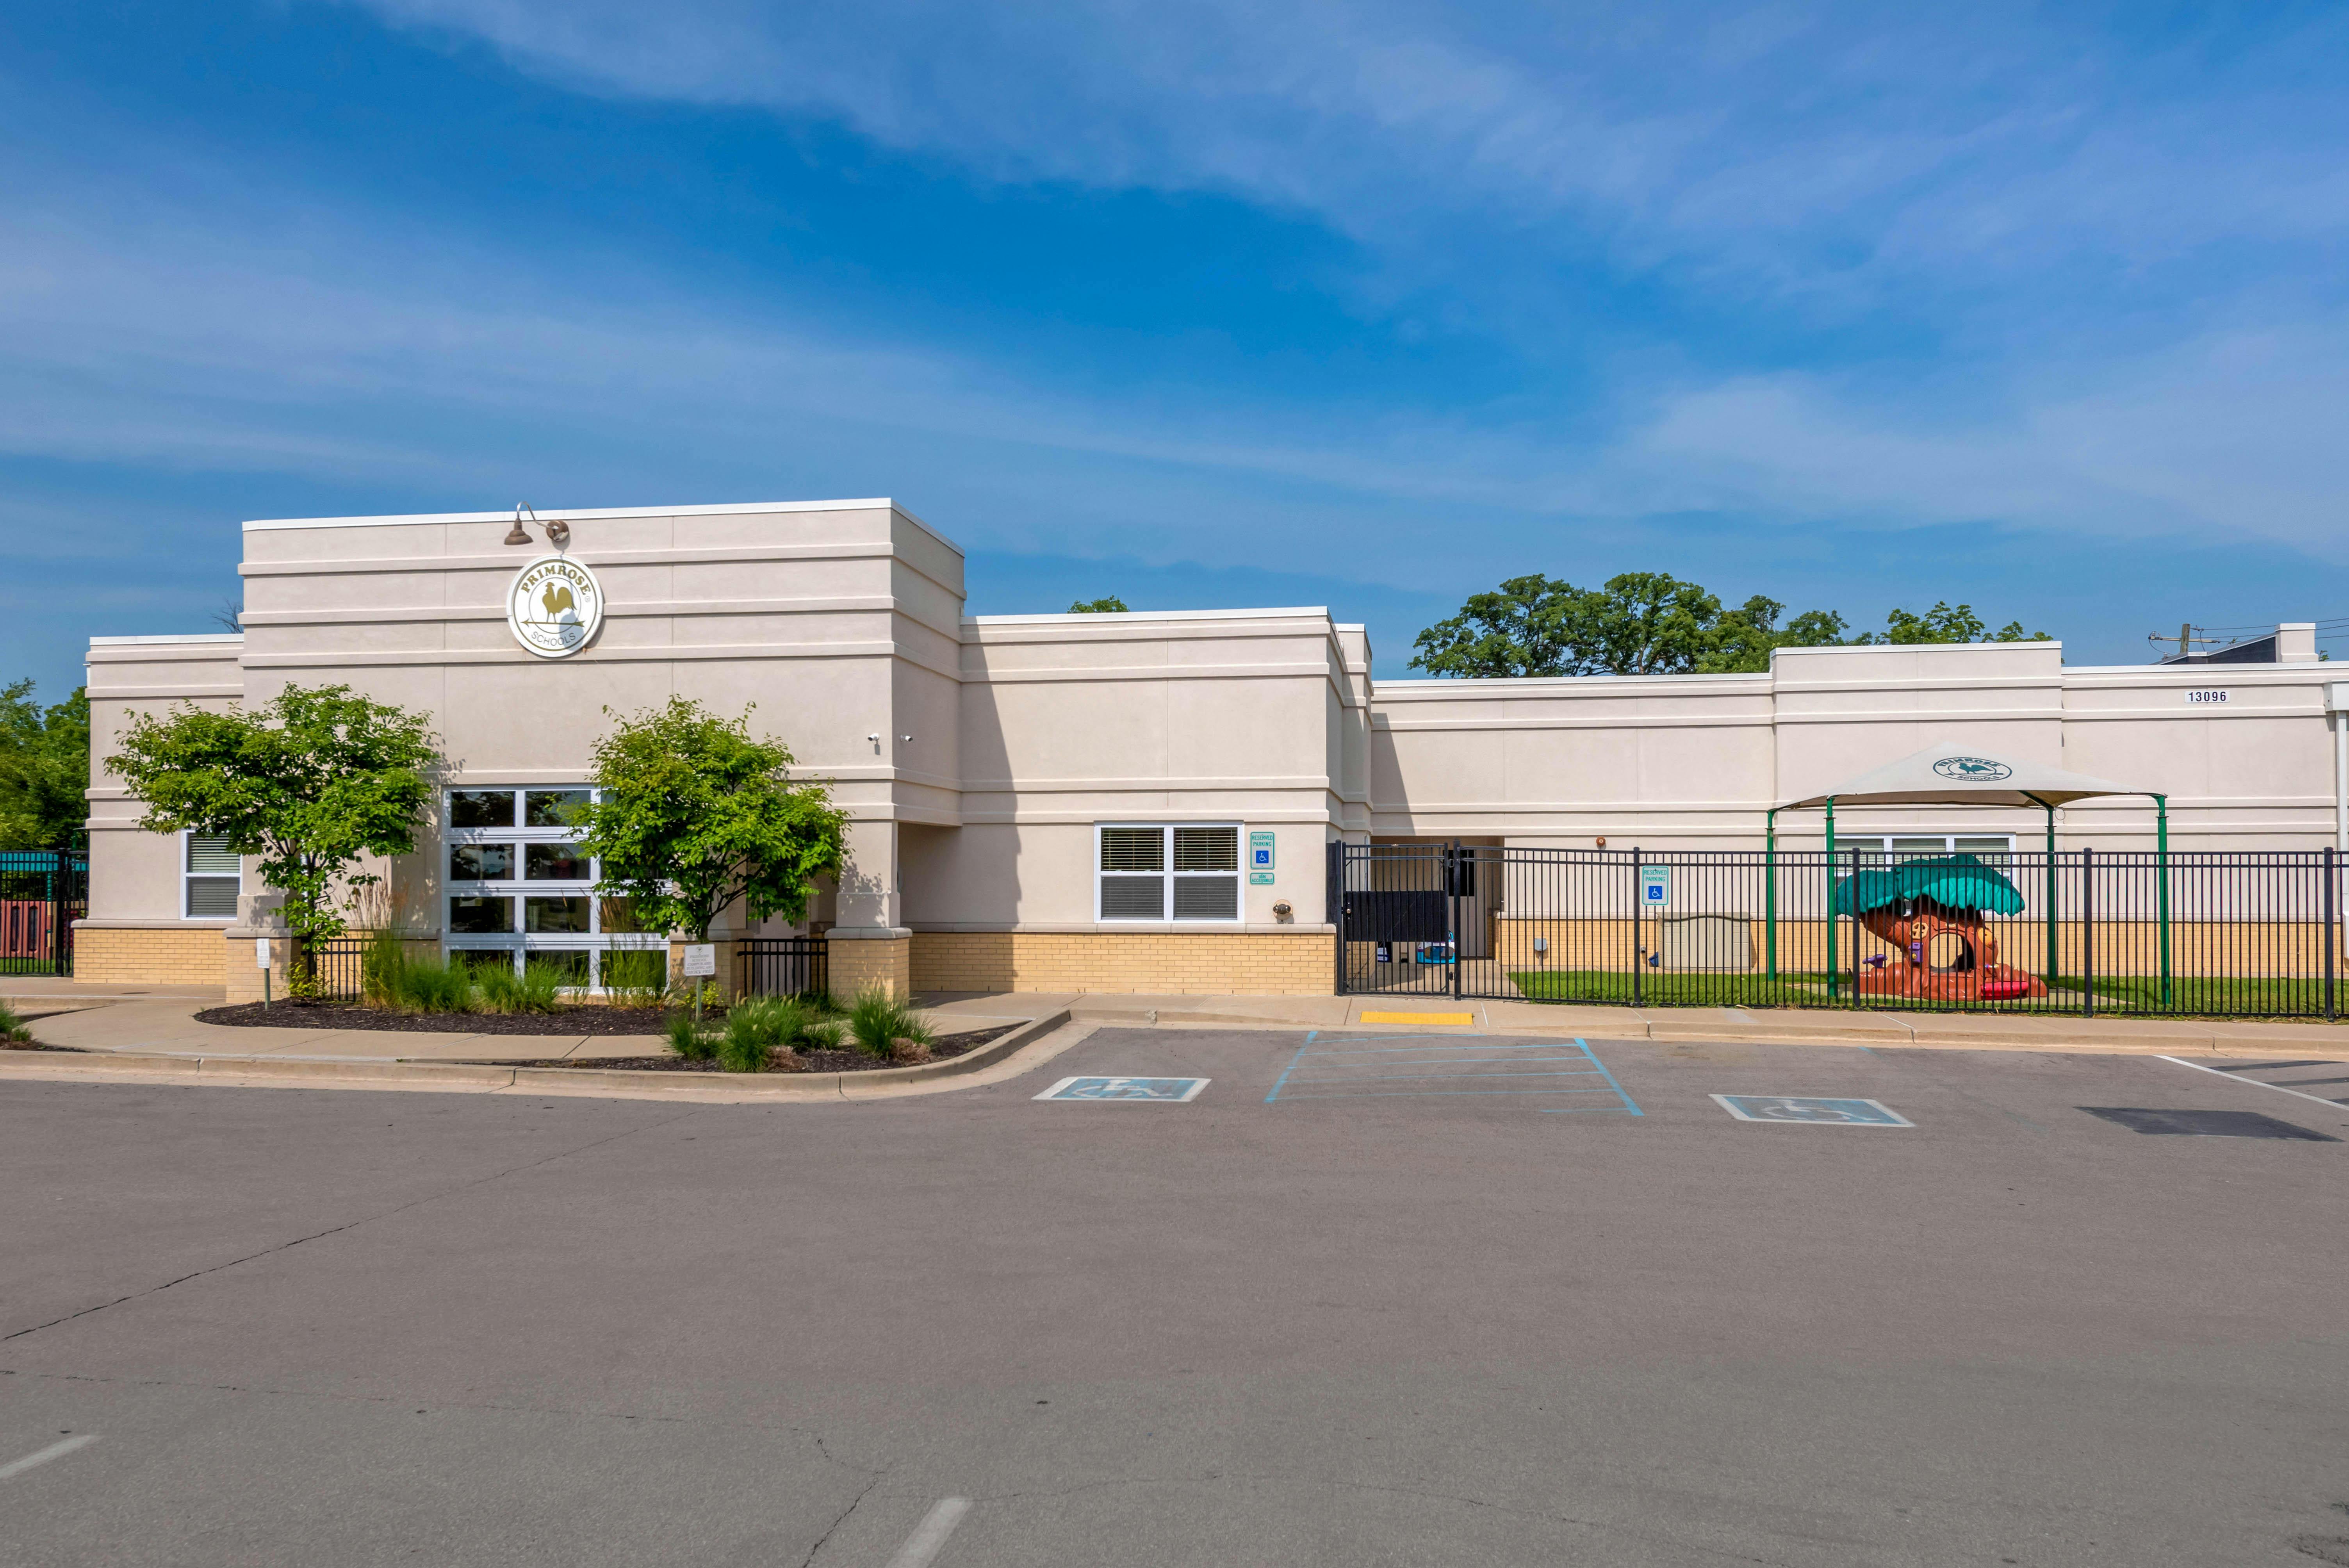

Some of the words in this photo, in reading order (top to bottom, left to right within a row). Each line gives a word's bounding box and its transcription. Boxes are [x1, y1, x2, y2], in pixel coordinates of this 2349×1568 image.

[520, 565, 591, 595] PRIMROSE
[531, 631, 576, 646] SCHOOLS
[2189, 691, 2226, 702] 13096
[1937, 758, 2000, 767] PRIMROSE
